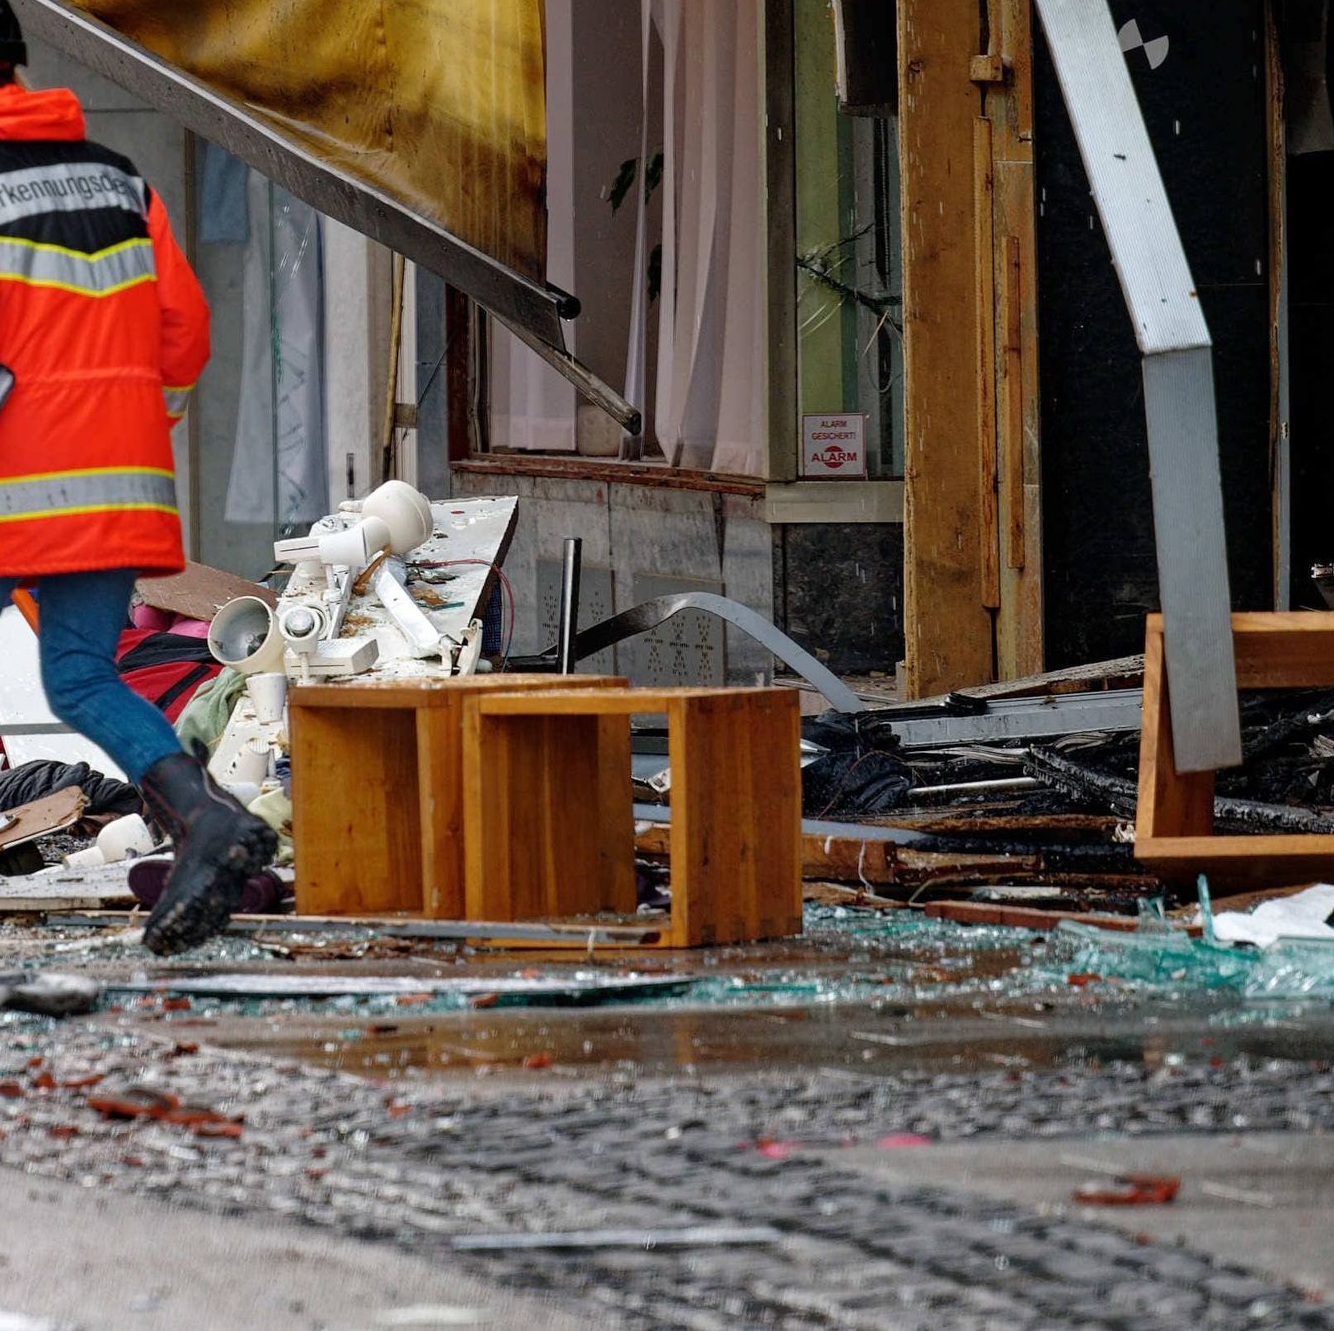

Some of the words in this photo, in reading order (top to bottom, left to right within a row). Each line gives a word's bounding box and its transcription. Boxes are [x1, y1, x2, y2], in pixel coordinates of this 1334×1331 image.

[820, 420, 847, 428] ALARM
[811, 431, 856, 440] GESICHERT!
[811, 452, 857, 462] ALARM
